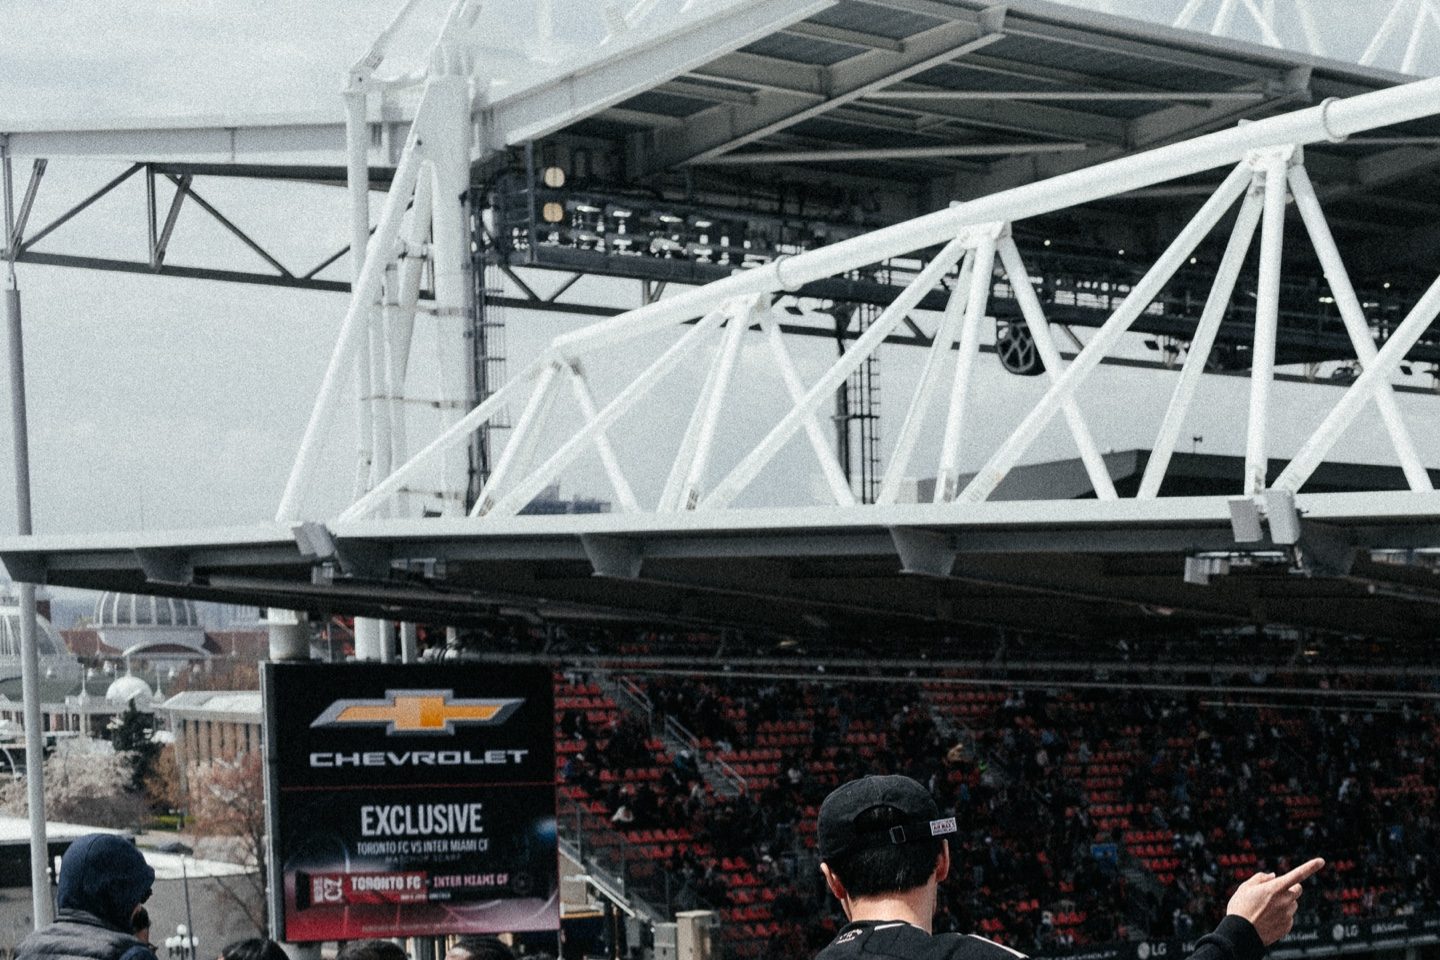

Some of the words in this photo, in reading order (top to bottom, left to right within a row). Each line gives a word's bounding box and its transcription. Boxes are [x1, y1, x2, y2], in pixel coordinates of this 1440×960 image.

[309, 749, 529, 767] CHEVROLET
[360, 802, 484, 836] EXCLUSIVE
[357, 841, 396, 855] TORONTO
[397, 841, 409, 854] FC
[411, 840, 422, 854] VS
[423, 839, 448, 853] INTER
[450, 838, 477, 852] MIAMI
[478, 838, 489, 852] CF
[351, 875, 400, 891] TORONTO
[406, 875, 421, 890] FC
[433, 875, 462, 888] INTER
[463, 873, 495, 887] MIAMI
[496, 873, 509, 885] CF
[1151, 942, 1168, 956] LG
